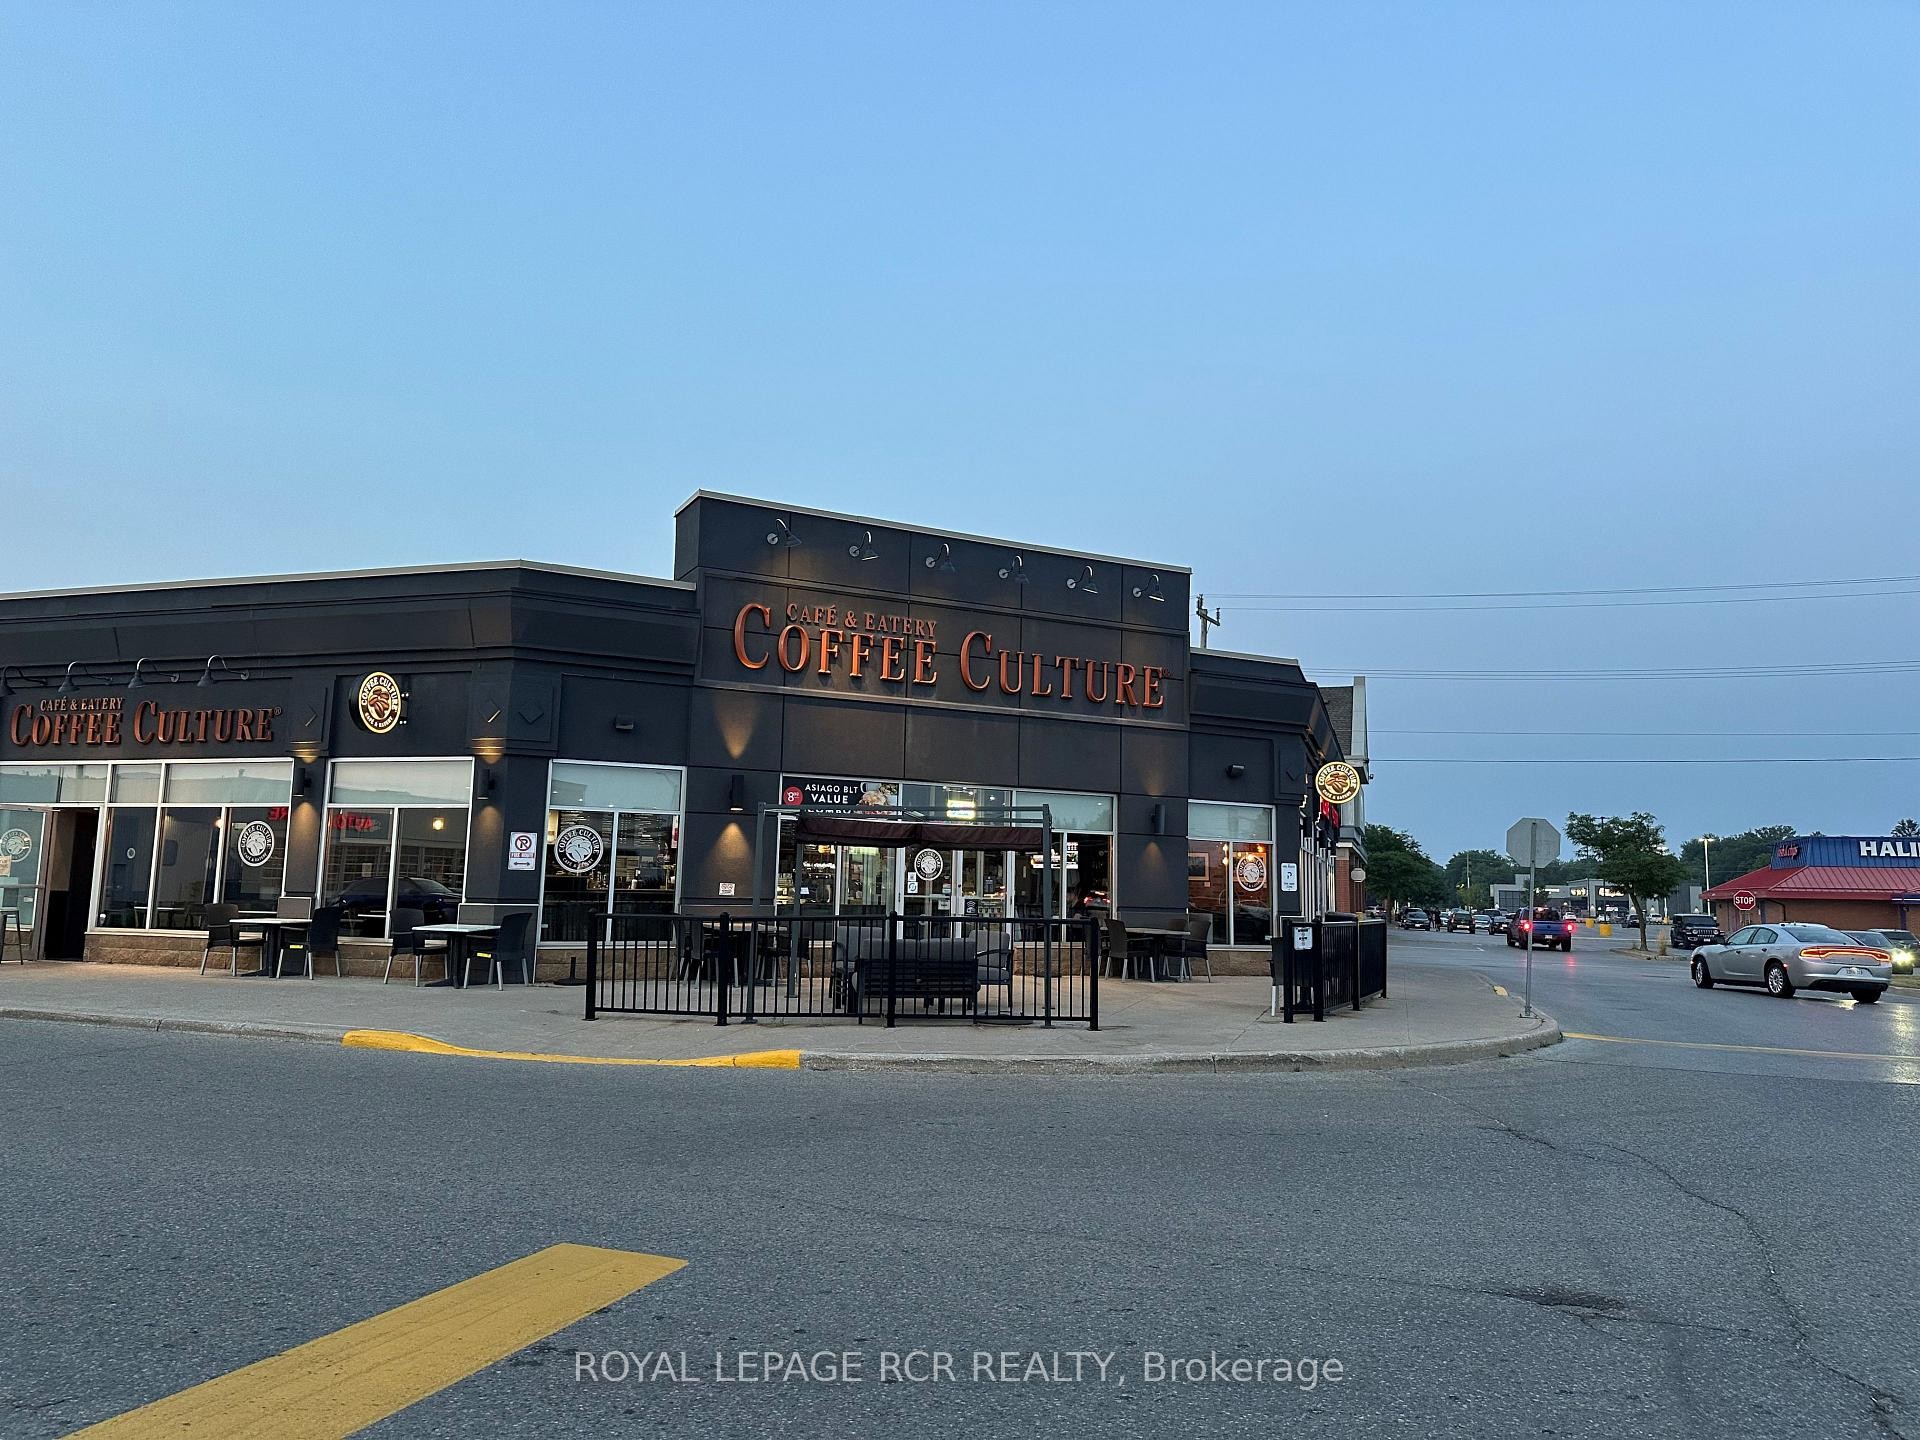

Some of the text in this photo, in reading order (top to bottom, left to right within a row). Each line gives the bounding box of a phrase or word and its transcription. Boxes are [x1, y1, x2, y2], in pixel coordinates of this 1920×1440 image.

[786, 603, 938, 638] CAFÉ & EATERY
[734, 603, 1165, 708] COFFEE CULTURE
[40, 696, 123, 712] CAFÉ & EATERY
[10, 703, 122, 746] COFFEE
[1319, 765, 1336, 786] COFFEE
[804, 783, 859, 794] ASIAGO BLT
[811, 793, 849, 804] VALUE
[559, 830, 578, 853] COFFEE
[579, 829, 600, 855] CULTURE
[1860, 840, 1920, 857] HALI
[1735, 896, 1754, 904] STOP
